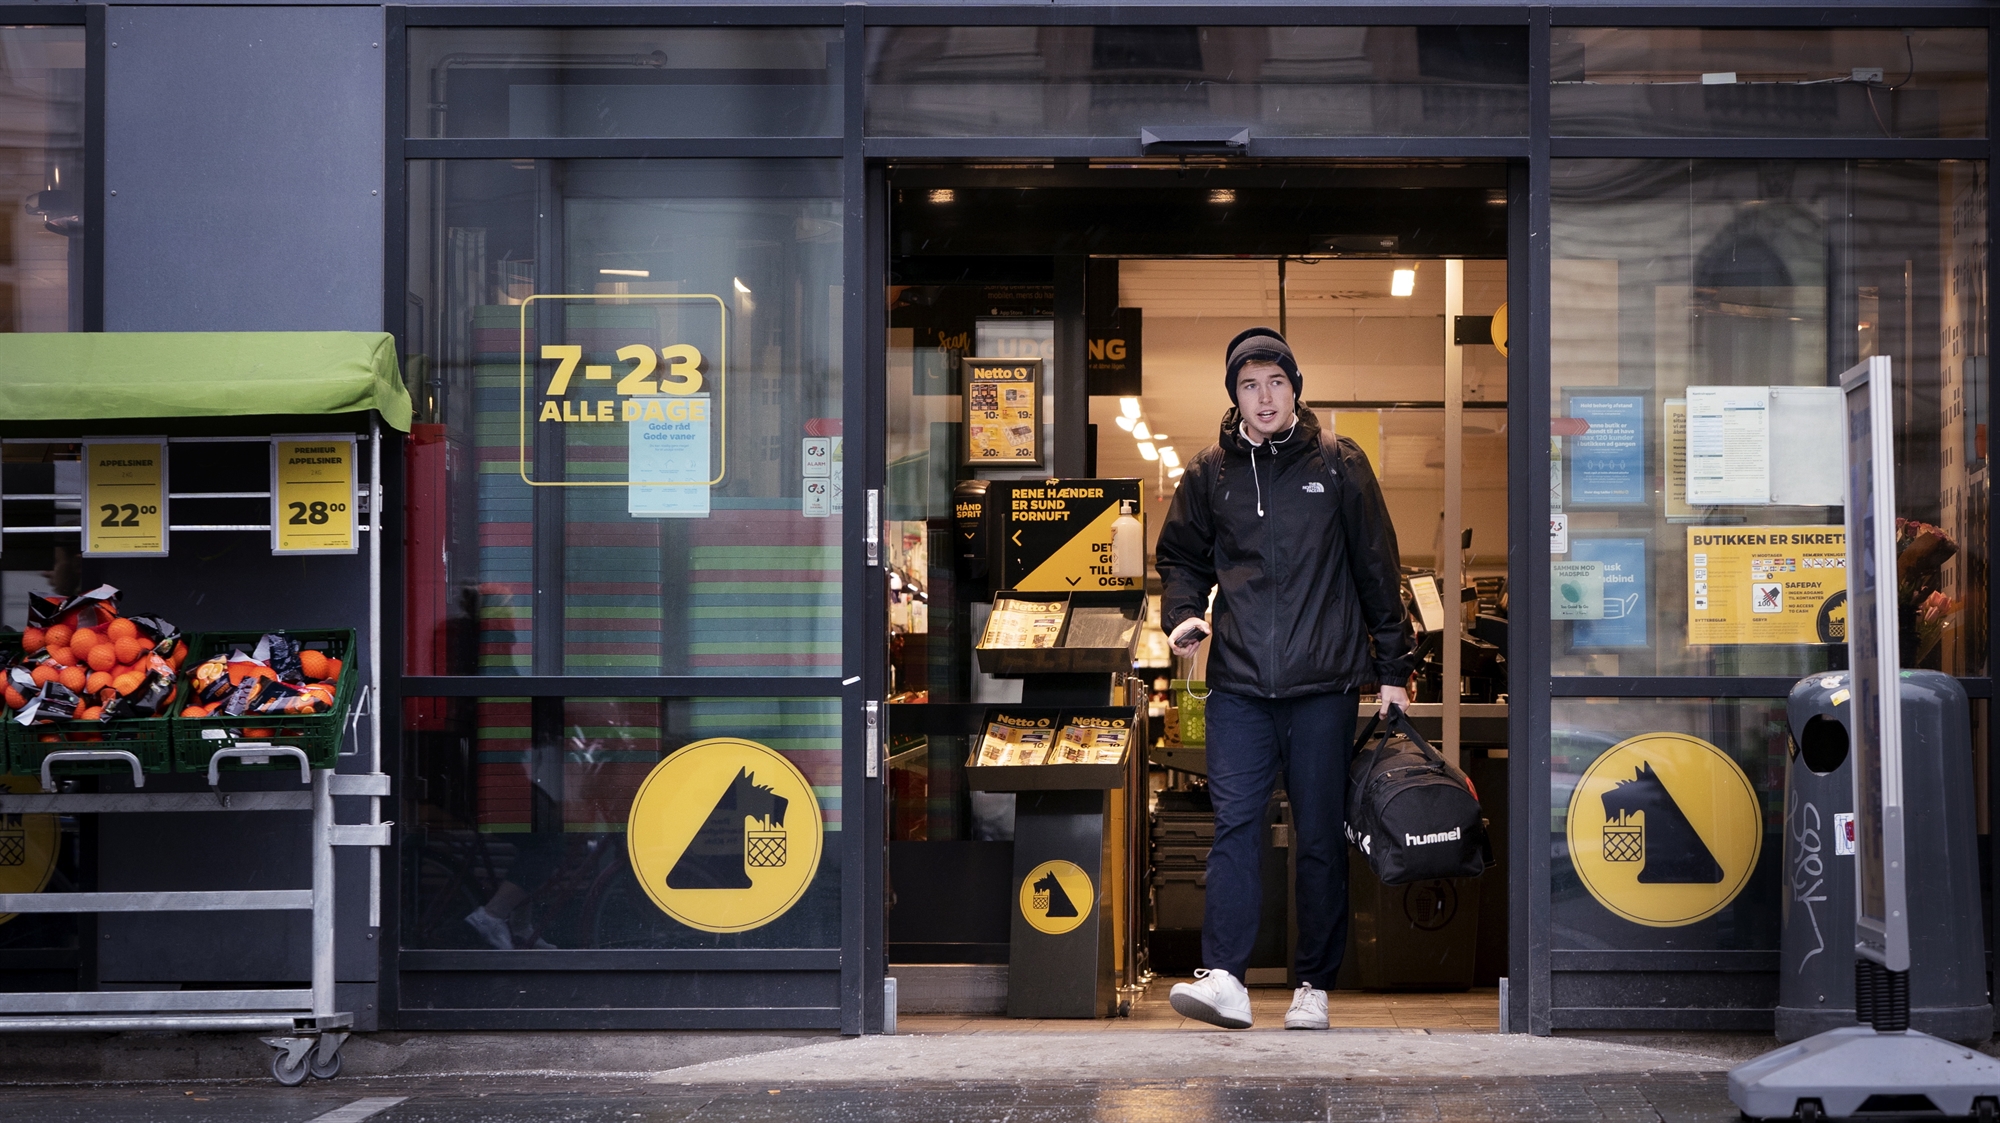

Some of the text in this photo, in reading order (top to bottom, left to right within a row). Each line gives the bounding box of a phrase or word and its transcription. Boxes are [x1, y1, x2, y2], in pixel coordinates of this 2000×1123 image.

[541, 344, 704, 395] 7-23
[974, 368, 1012, 379] Netto
[539, 401, 706, 422] ALLE DAGE
[1012, 488, 1103, 498] RENE HÆNDER
[956, 502, 982, 511] HÅND
[1012, 500, 1065, 510] ER SUND
[1012, 511, 1070, 521] FORNUFT
[1694, 534, 1766, 545] BUTIKKEN
[1770, 534, 1788, 544] ER
[1008, 601, 1046, 612] Netto
[997, 714, 1110, 727] Netto Netto
[1406, 827, 1460, 846] hummel
